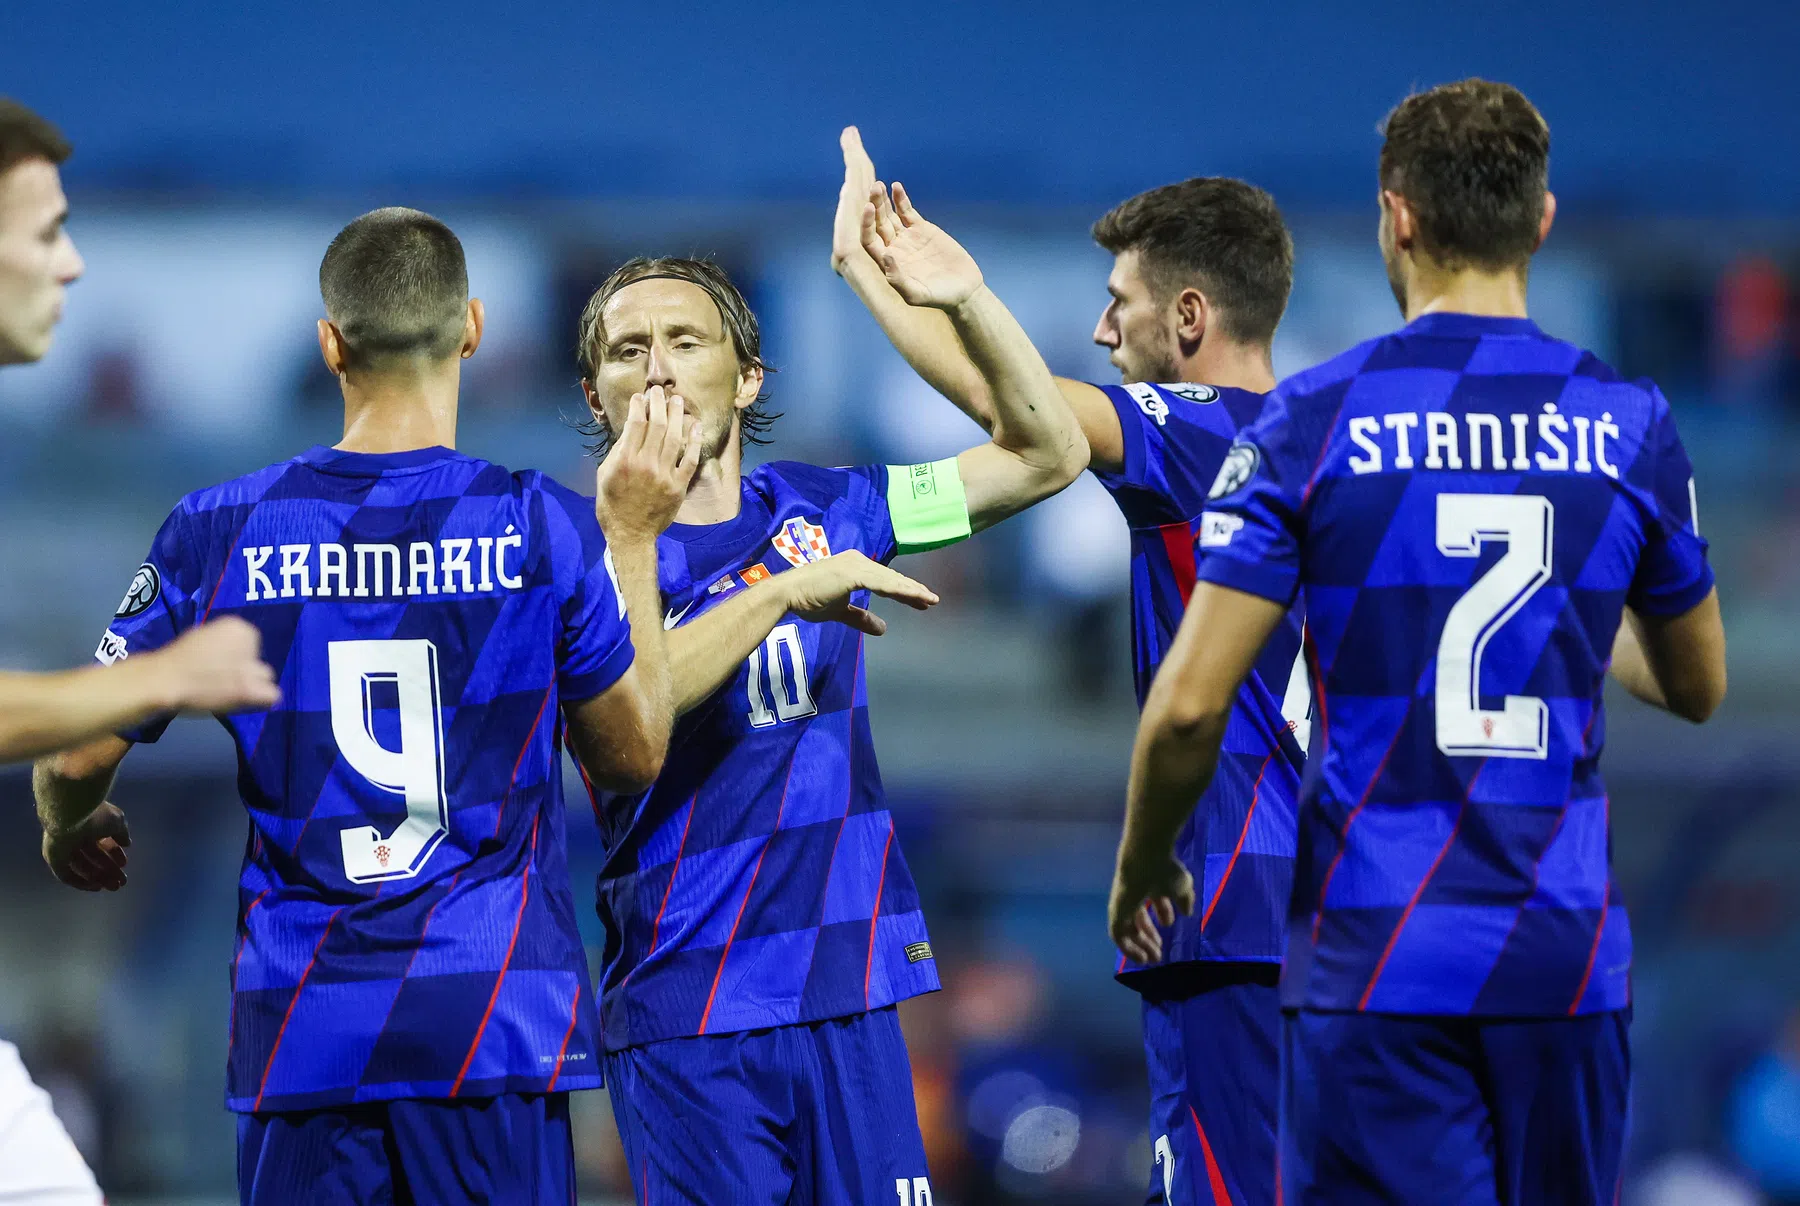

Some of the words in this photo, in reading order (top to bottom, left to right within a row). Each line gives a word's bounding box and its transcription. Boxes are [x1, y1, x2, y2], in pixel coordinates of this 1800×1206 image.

[1349, 402, 1620, 480] STANIŠIĆ
[243, 523, 523, 601] KRAMARIĆ
[748, 623, 818, 728] 10
[1435, 493, 1554, 760] 2
[328, 638, 449, 884] 9
